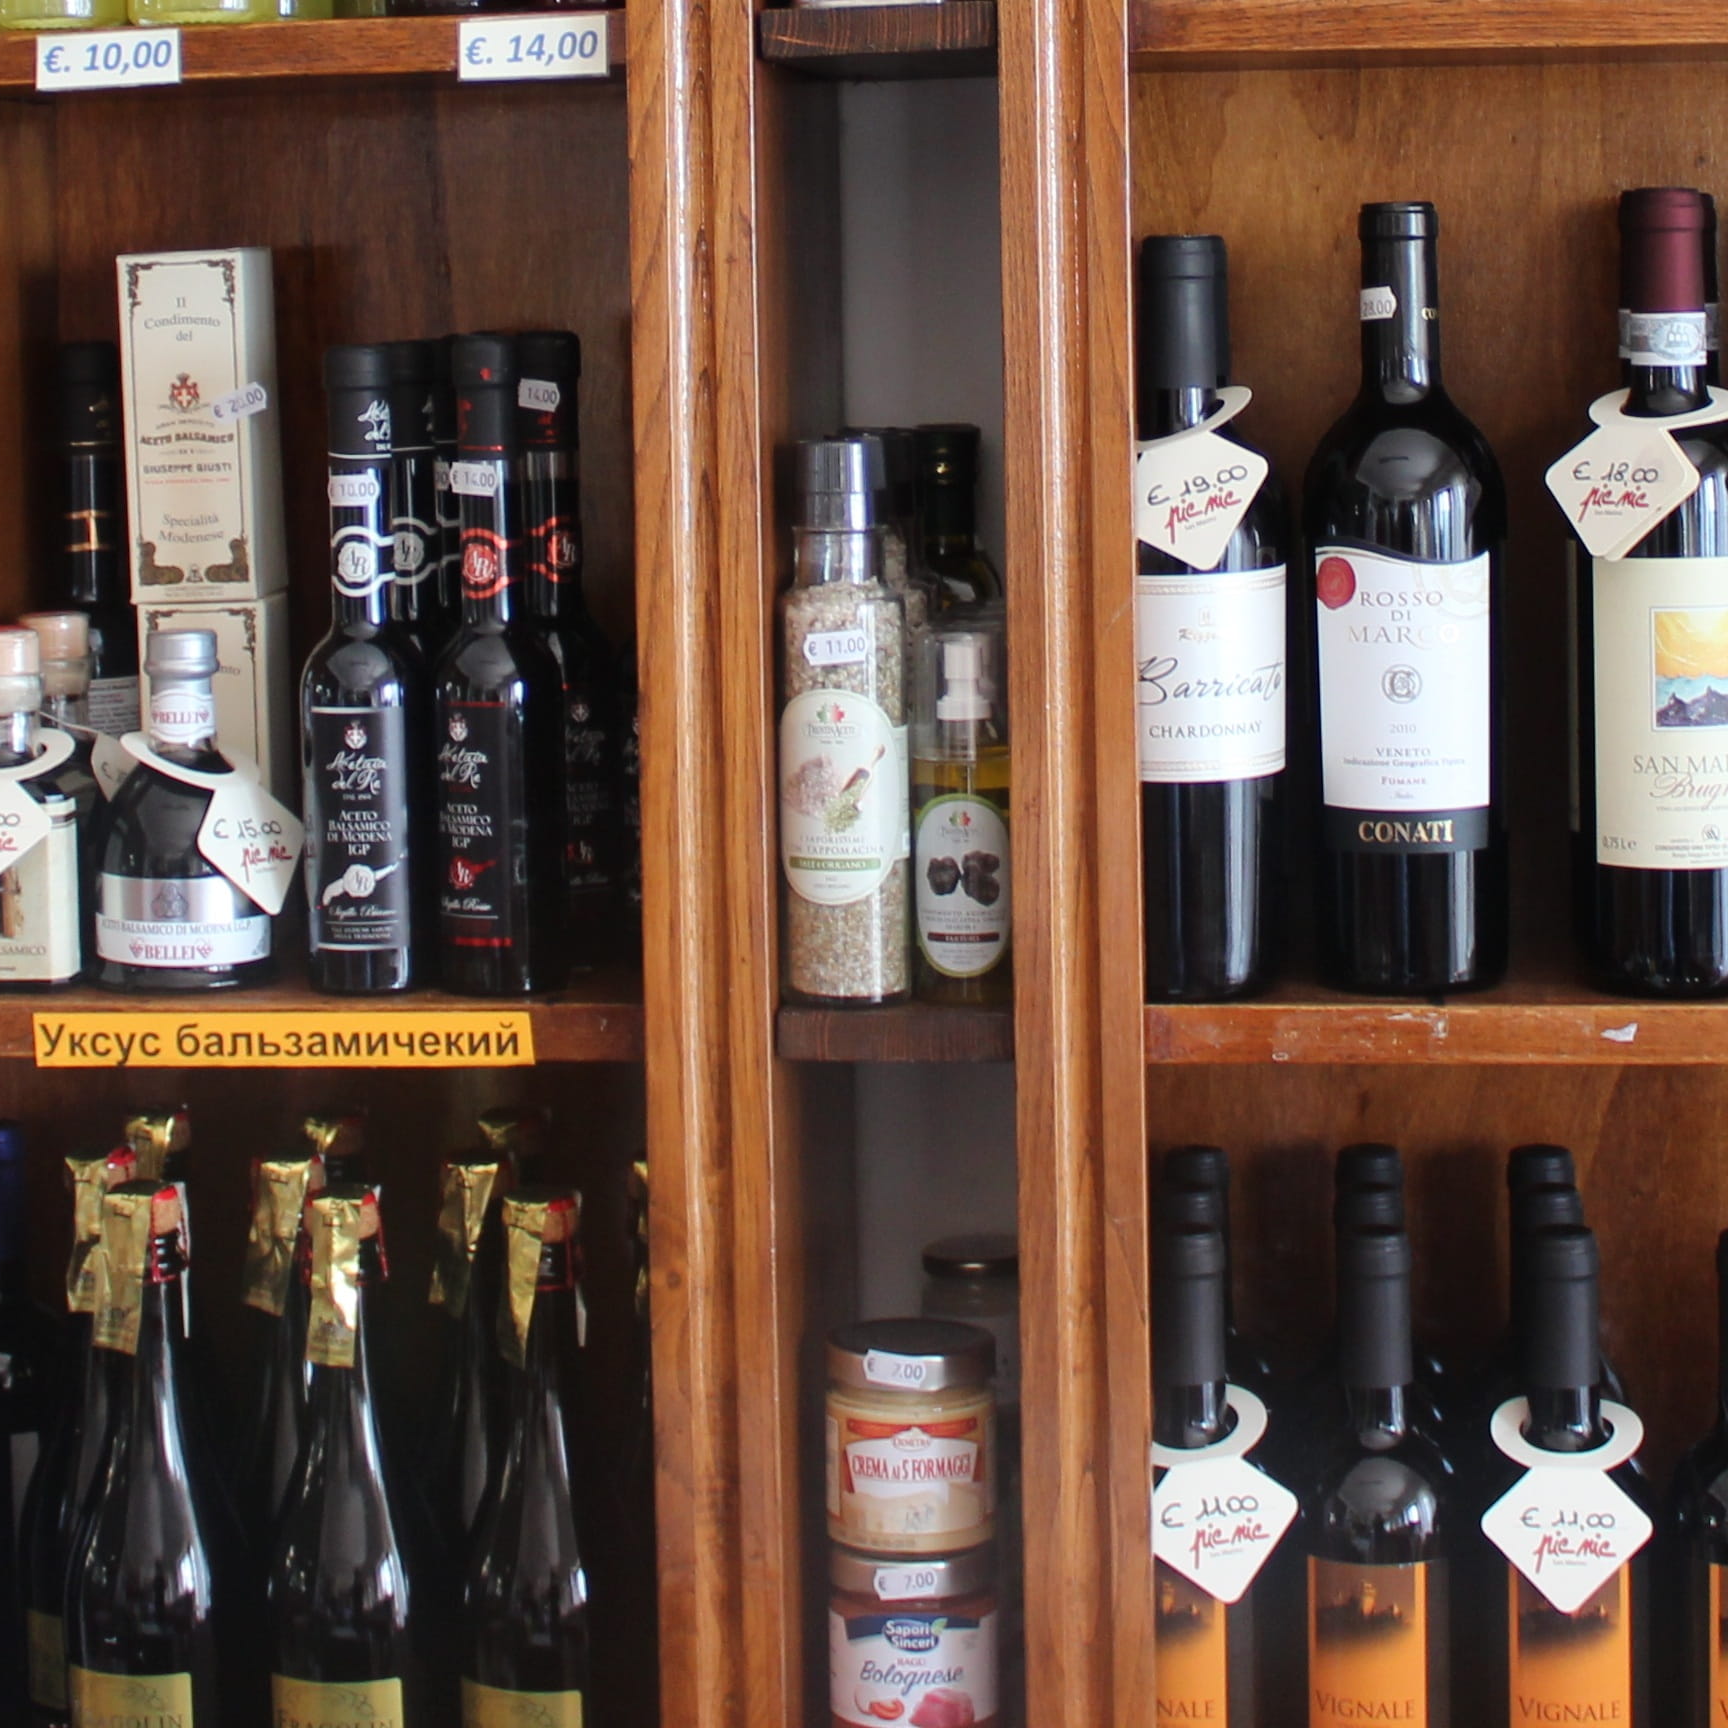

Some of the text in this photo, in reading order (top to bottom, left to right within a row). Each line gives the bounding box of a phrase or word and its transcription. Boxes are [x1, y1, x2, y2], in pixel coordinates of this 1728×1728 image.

[82, 39, 172, 73] 10,00
[506, 29, 598, 64] 14,00
[143, 313, 222, 333] Condimento
[157, 527, 224, 545] Modenese
[1148, 719, 1264, 740] CHARDONNAY
[1632, 755, 1677, 774] SAN
[1358, 818, 1454, 844] CONATI
[143, 944, 197, 961] BELLEI
[38, 1021, 520, 1062] Уксус бальзамичекий
[892, 1635, 936, 1652] Sinceri
[860, 1662, 965, 1687] Bolognese
[1316, 1691, 1416, 1721] VIGNALE
